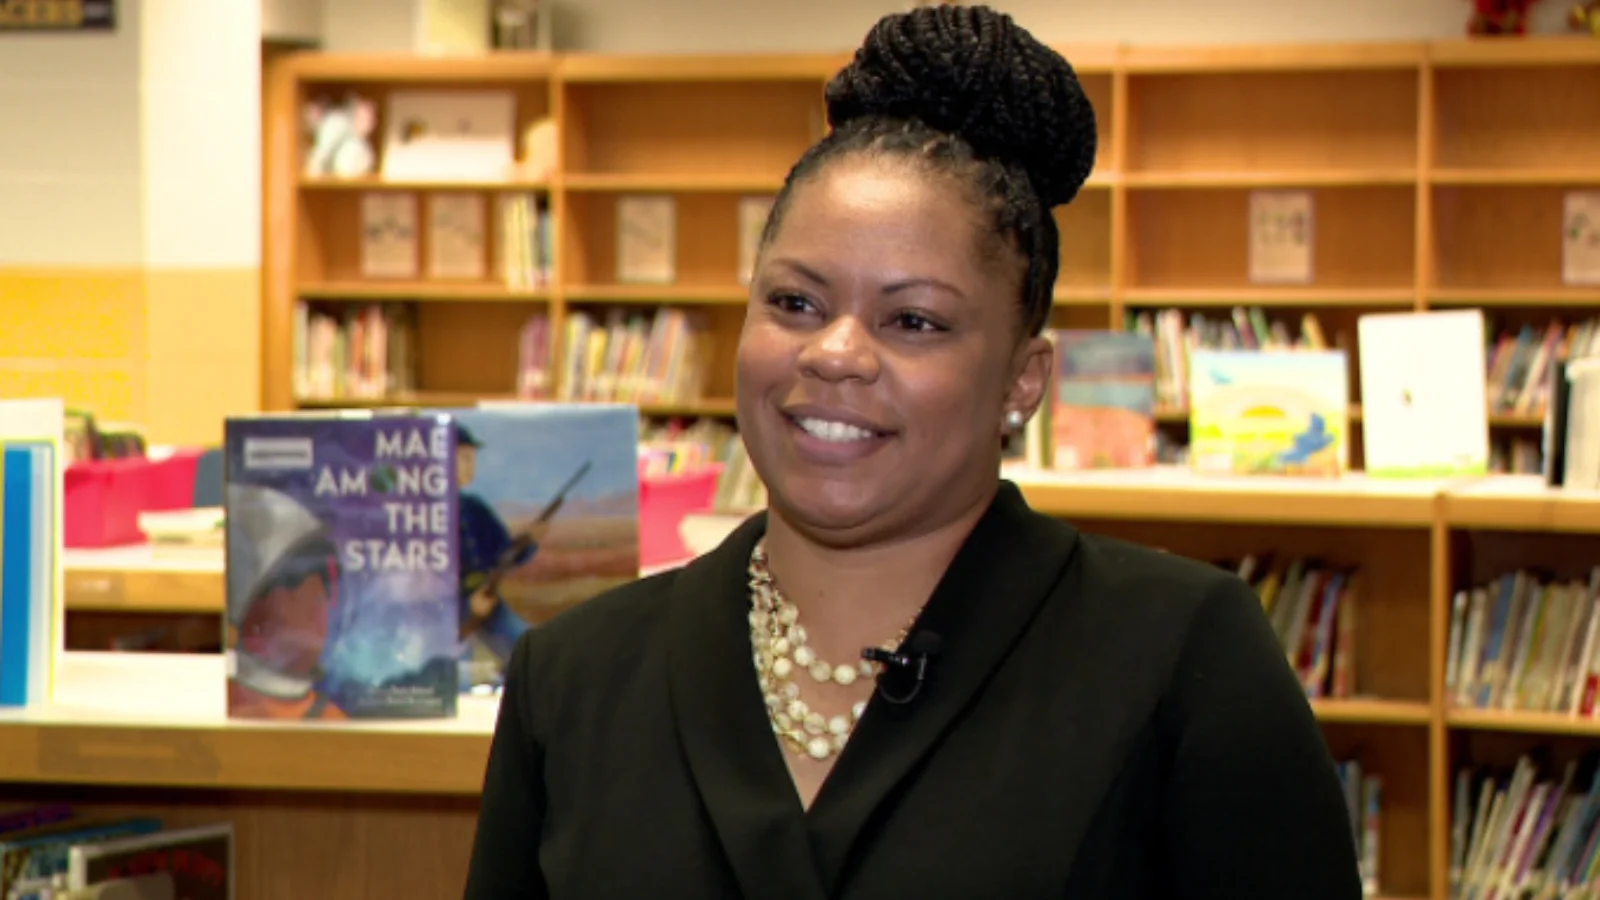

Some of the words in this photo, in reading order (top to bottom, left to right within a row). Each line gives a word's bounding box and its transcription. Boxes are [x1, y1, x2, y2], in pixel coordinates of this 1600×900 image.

[375, 427, 448, 459] MAE
[314, 463, 448, 496] AMONG
[384, 501, 448, 534] THE
[345, 538, 450, 571] STARS
